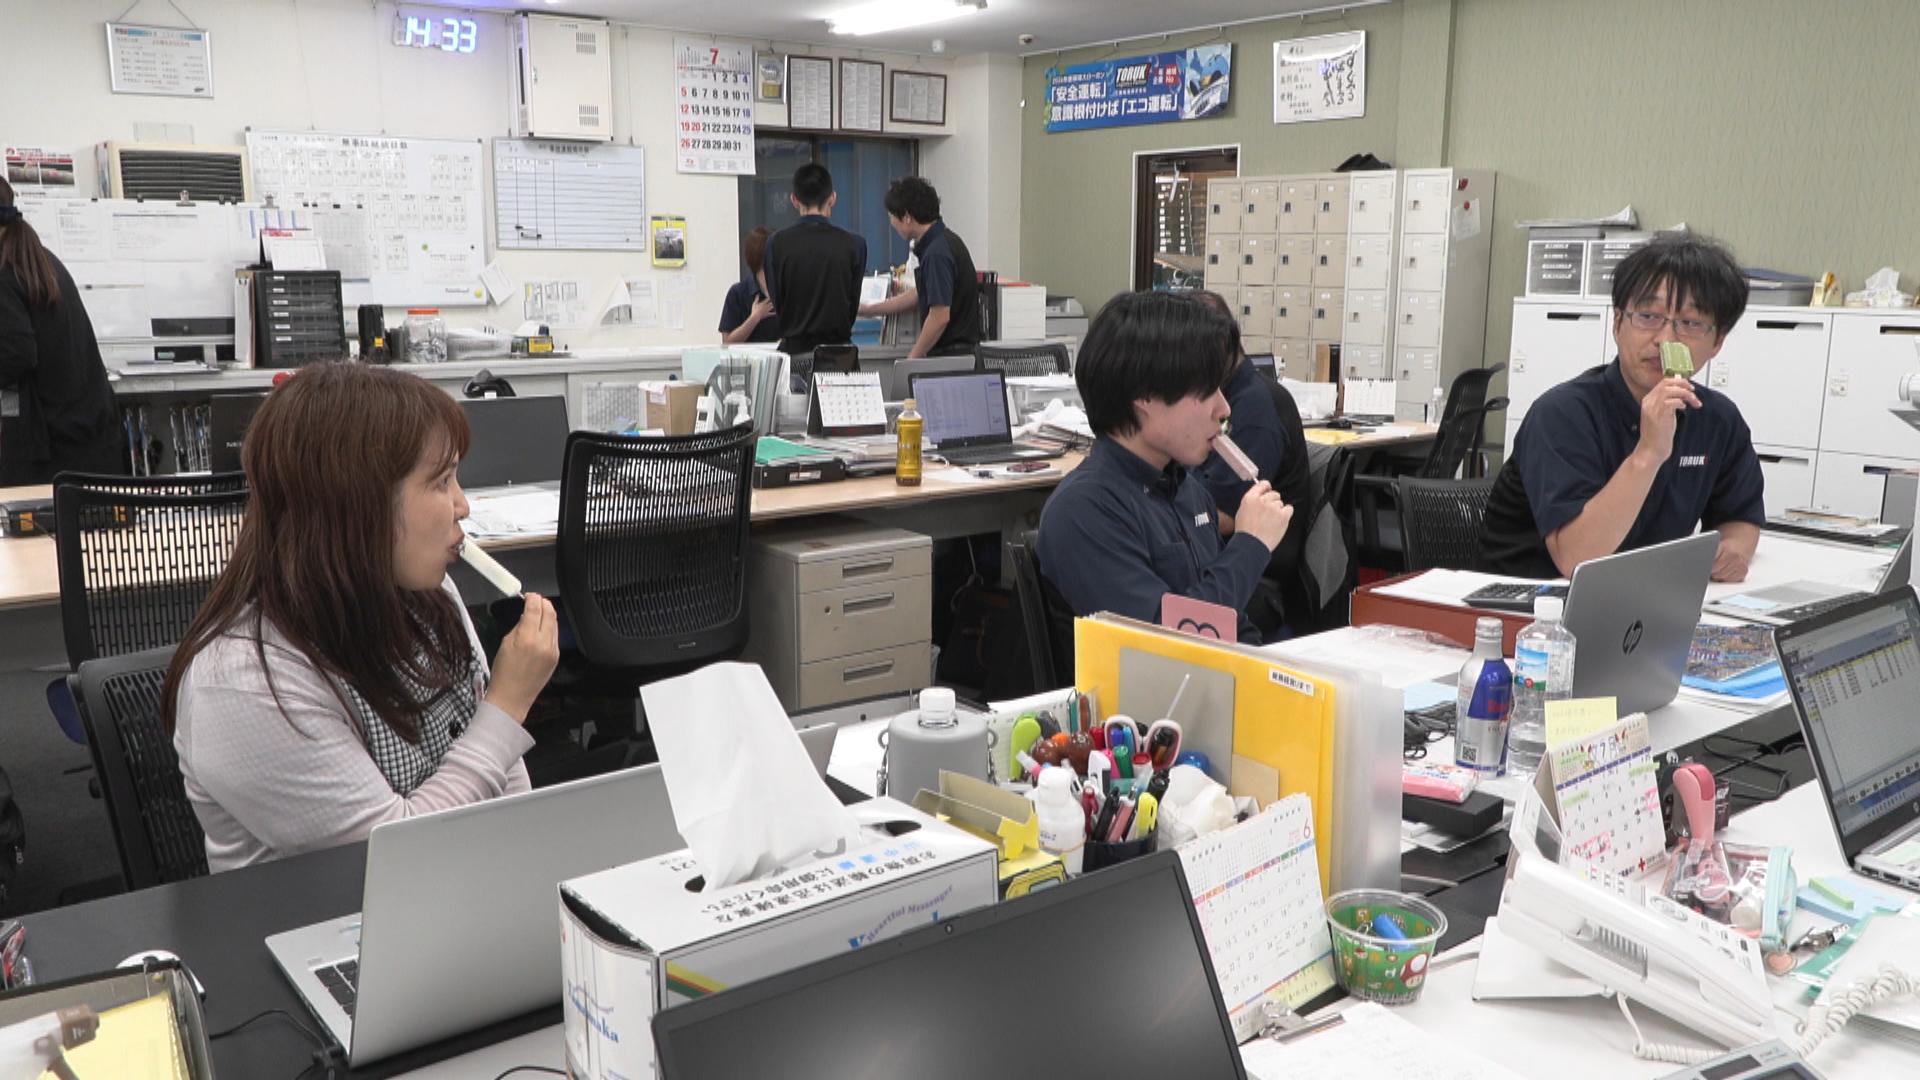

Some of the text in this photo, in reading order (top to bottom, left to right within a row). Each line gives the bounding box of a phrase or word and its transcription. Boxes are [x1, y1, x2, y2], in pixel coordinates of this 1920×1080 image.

[710, 48, 719, 64] 7
[713, 72, 717, 81] 1
[722, 73, 728, 83] 2
[732, 74, 738, 83] 3
[742, 75, 748, 83] 4
[1116, 63, 1148, 83] TORUK
[681, 87, 749, 101] 5 6 7 8 9 10 11
[1051, 82, 1107, 102] 「安全運転」
[681, 104, 750, 118] 12 13 14 15 16 17 18
[681, 122, 751, 135] 19 20 21 22 23 24 25
[681, 139, 741, 151] 26 27 28 29 30 31
[1304, 817, 1311, 839] 6
